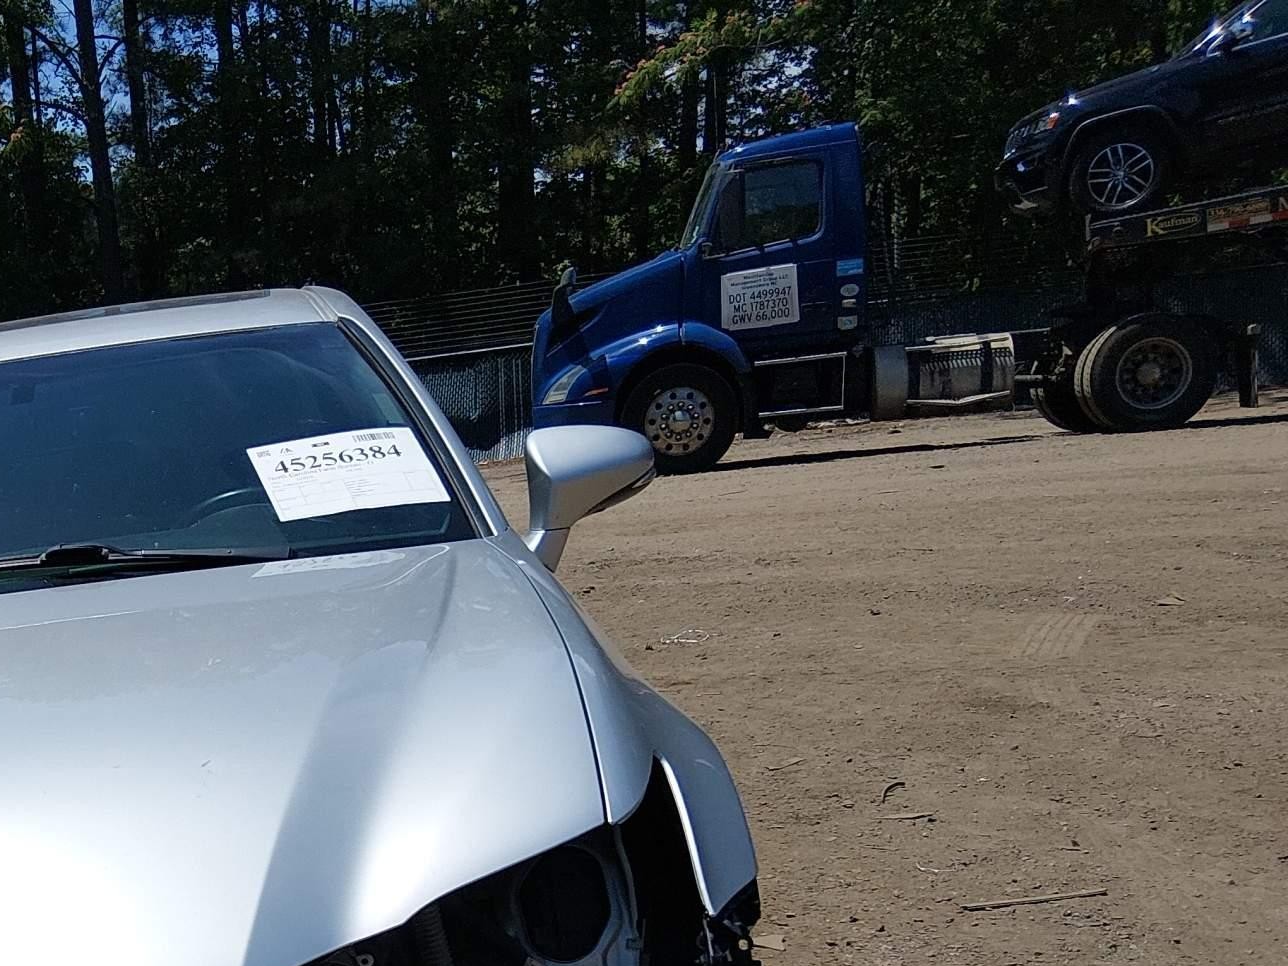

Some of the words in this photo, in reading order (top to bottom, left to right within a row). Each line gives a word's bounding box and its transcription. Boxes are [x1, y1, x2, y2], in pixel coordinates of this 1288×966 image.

[1144, 214, 1199, 238] Kaufman
[729, 292, 747, 304] DOT
[749, 286, 792, 300] 4499947
[733, 303, 747, 313] MC
[750, 297, 788, 311] 1787370
[732, 312, 752, 324] GWV
[755, 307, 790, 321] 66,000
[274, 444, 403, 474] 45256384
